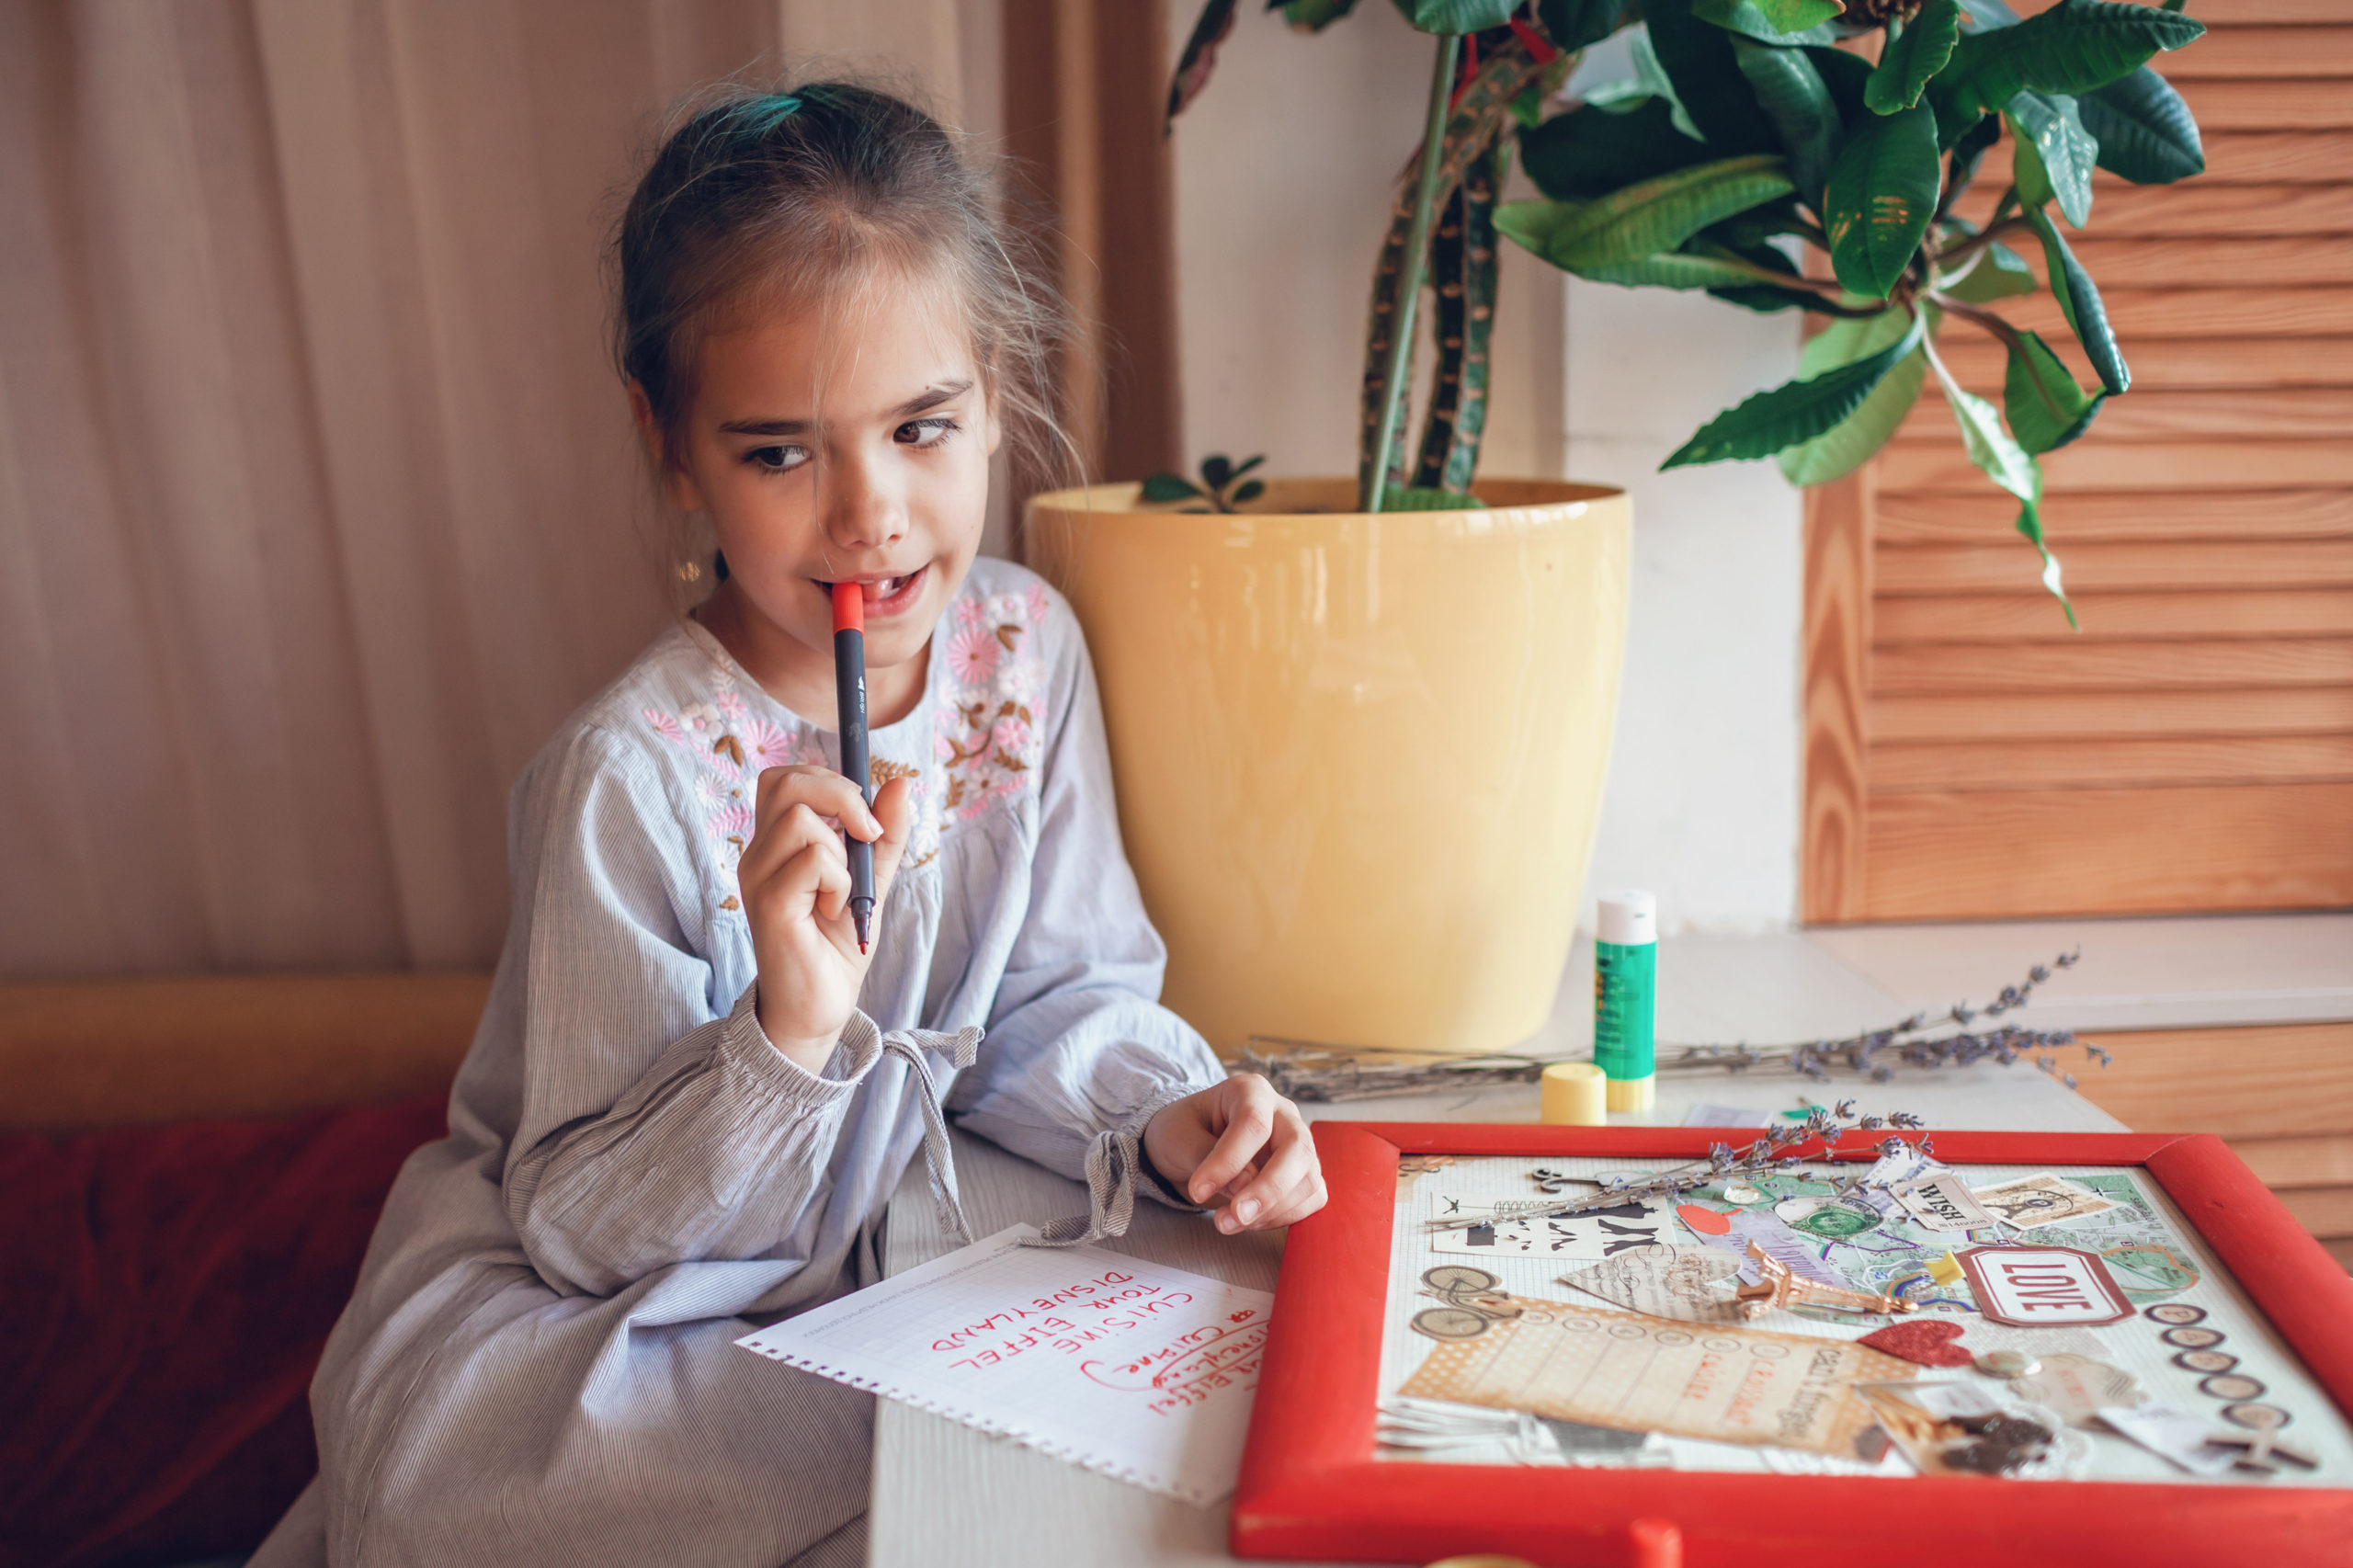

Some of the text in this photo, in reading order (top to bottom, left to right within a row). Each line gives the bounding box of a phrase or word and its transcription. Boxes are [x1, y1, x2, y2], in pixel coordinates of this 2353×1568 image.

[1917, 1183, 1966, 1221] WISH
[2001, 1264, 2093, 1312] LOVE
[948, 1317, 1076, 1369] EIFFEL
